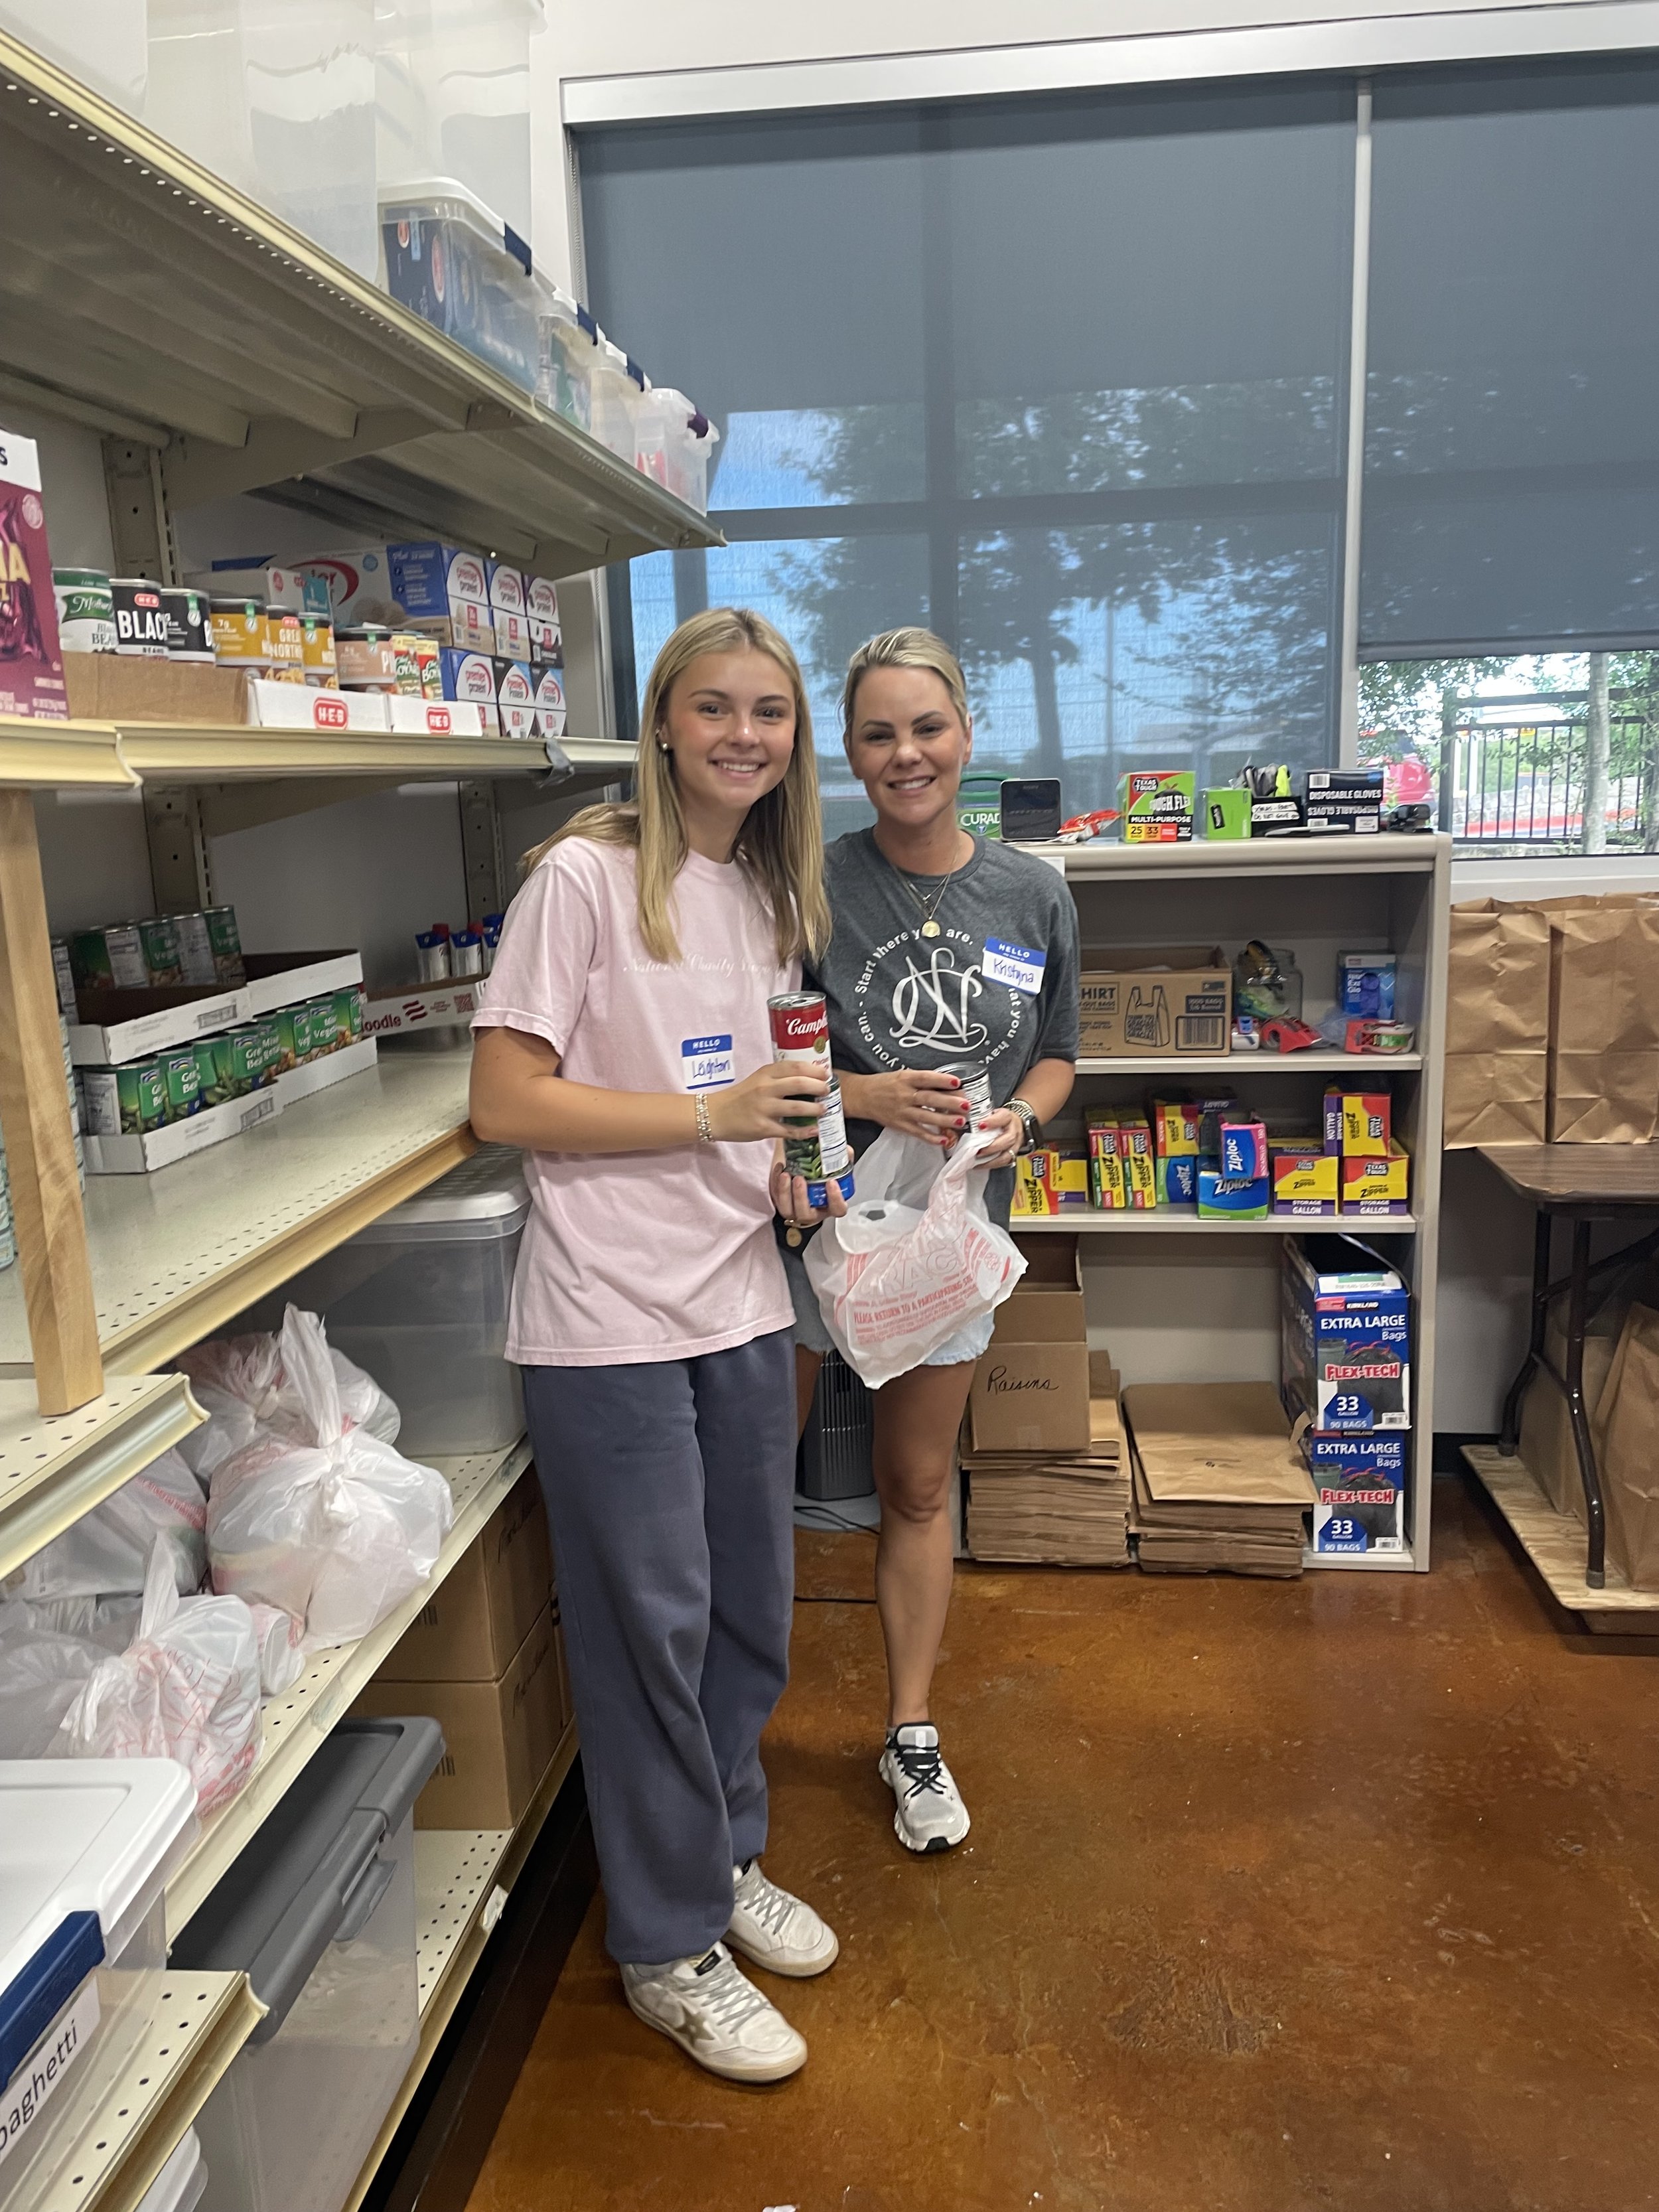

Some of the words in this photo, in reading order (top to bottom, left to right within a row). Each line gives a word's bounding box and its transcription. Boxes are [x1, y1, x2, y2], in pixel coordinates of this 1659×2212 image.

[1309, 790, 1352, 800] DISPOSABLE
[1353, 789, 1382, 799] GLOVES
[1307, 806, 1334, 816] GLOVES
[1335, 805, 1378, 815] DISPOSABLE
[999, 943, 1031, 958] HELLO
[855, 960, 877, 995] Start
[946, 928, 974, 946] are.
[1009, 1009, 1022, 1039] you
[362, 1013, 402, 1033] oodle
[857, 1011, 875, 1043] can.
[692, 1038, 721, 1050] HELLO
[871, 1043, 900, 1068] you
[1327, 1112, 1336, 1141] GALLON
[1226, 1137, 1244, 1172] Ziploc
[1102, 1156, 1117, 1189] ZIPPER
[1133, 1156, 1147, 1189] ZIPPER
[1177, 1165, 1192, 1196] Ziploc
[1214, 1177, 1253, 1195] Ziploc
[1024, 1178, 1038, 1213] ZIPPER
[1292, 1206, 1323, 1215] GALLON
[1360, 1206, 1390, 1215] GALLON
[874, 1307, 901, 1321] RETURN
[902, 1304, 911, 1314] TO
[912, 1302, 918, 1311] A
[917, 1281, 962, 1307] PARTICIPATING
[1321, 1317, 1362, 1330] EXTRA
[1364, 1314, 1406, 1328] LARGE
[1382, 1330, 1407, 1343] Bags
[987, 1365, 1060, 1395] Raisins
[1326, 1362, 1401, 1382] FLEX-TECH
[1336, 1396, 1360, 1412] 33
[1329, 1420, 1341, 1429] 90
[1342, 1419, 1368, 1428] BAGS
[1317, 1443, 1358, 1455] EXTRA
[1360, 1442, 1402, 1455] LARGE
[1376, 1457, 1402, 1469] Bags
[1320, 1488, 1396, 1505] FLEX-TECH
[1331, 1519, 1354, 1535] 33
[1337, 1543, 1362, 1552] BAGS
